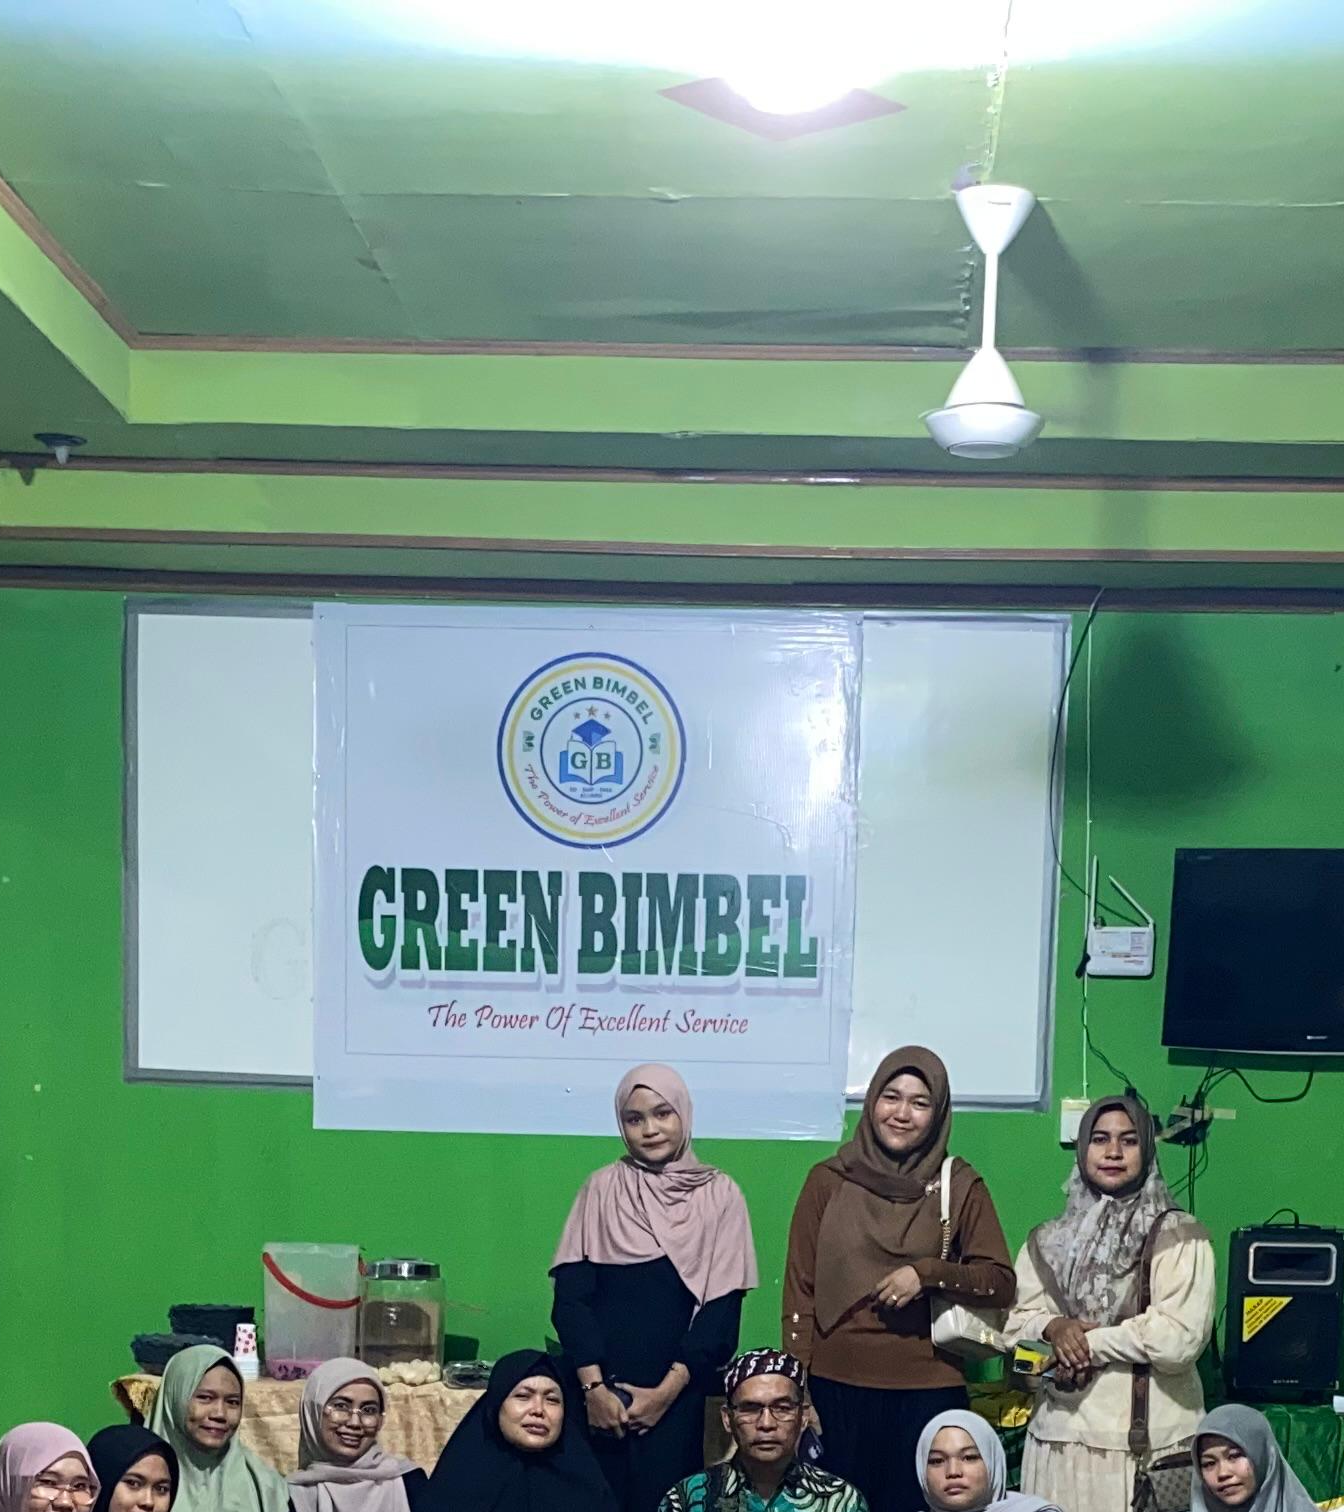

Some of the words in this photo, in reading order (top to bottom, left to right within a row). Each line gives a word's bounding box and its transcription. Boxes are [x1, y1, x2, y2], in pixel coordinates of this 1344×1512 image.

[530, 676, 587, 721] GREEN
[592, 676, 654, 725] BIMBEL
[537, 790, 569, 818] Power
[357, 865, 564, 975] GREEN
[577, 872, 819, 979] BIMBEL
[427, 1000, 467, 1029] The
[474, 1003, 540, 1029] Power
[545, 1003, 576, 1037] Of
[577, 1003, 671, 1037] Excellent
[675, 1008, 749, 1035] Service
